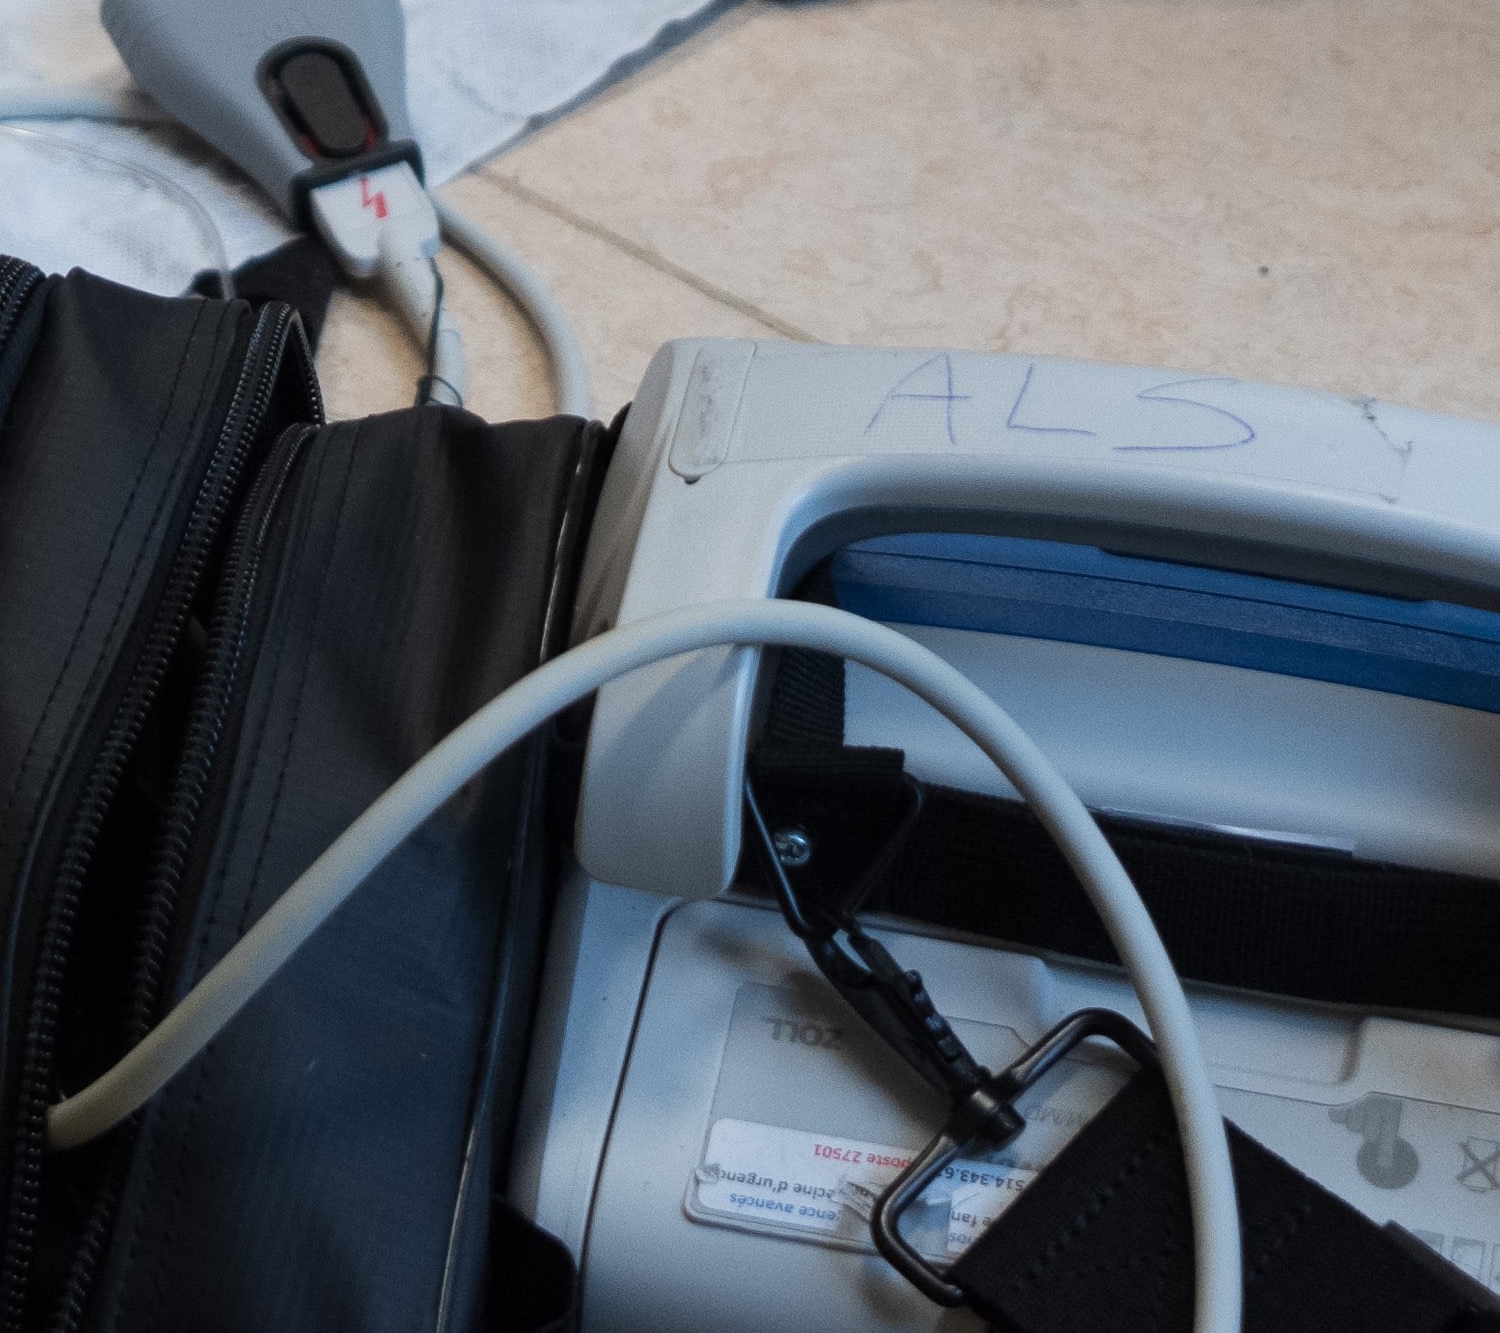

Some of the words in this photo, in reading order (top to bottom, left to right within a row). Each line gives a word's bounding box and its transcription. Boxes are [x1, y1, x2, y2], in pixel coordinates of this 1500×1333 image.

[865, 353, 1256, 452] ALS
[764, 1019, 844, 1051] ZOLL
[814, 1144, 862, 1164] 27501
[716, 1171, 788, 1194] d'urgenc
[937, 1166, 1026, 1192] 514.343.6
[729, 1193, 794, 1213] avancés
